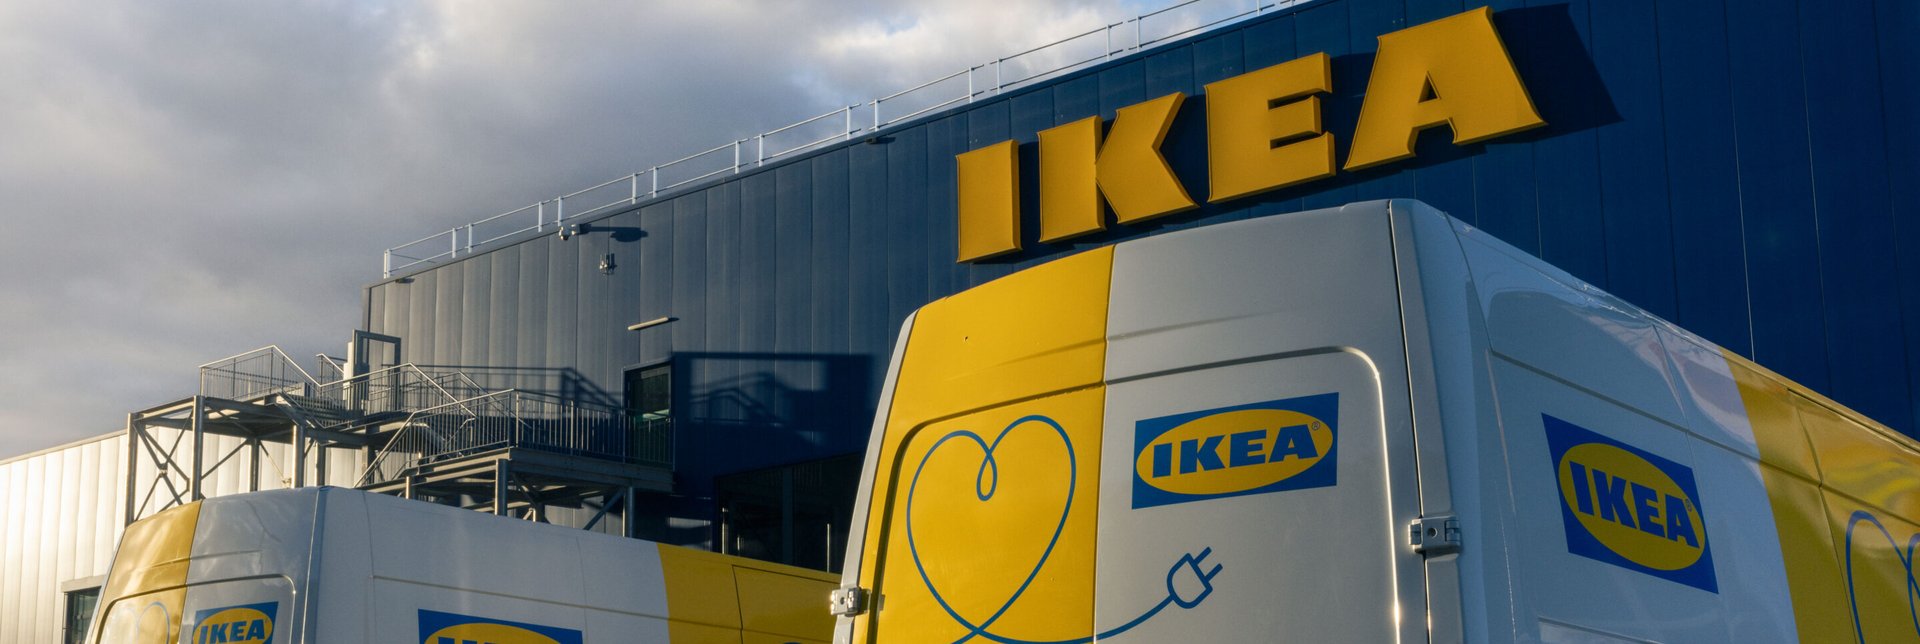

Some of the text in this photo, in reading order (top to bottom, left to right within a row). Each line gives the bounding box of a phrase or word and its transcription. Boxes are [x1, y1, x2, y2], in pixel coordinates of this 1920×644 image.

[956, 5, 1547, 263] IKEA
[1152, 424, 1319, 478] IKEA
[1569, 460, 1700, 549] IKEA
[198, 619, 266, 644] IKEA
